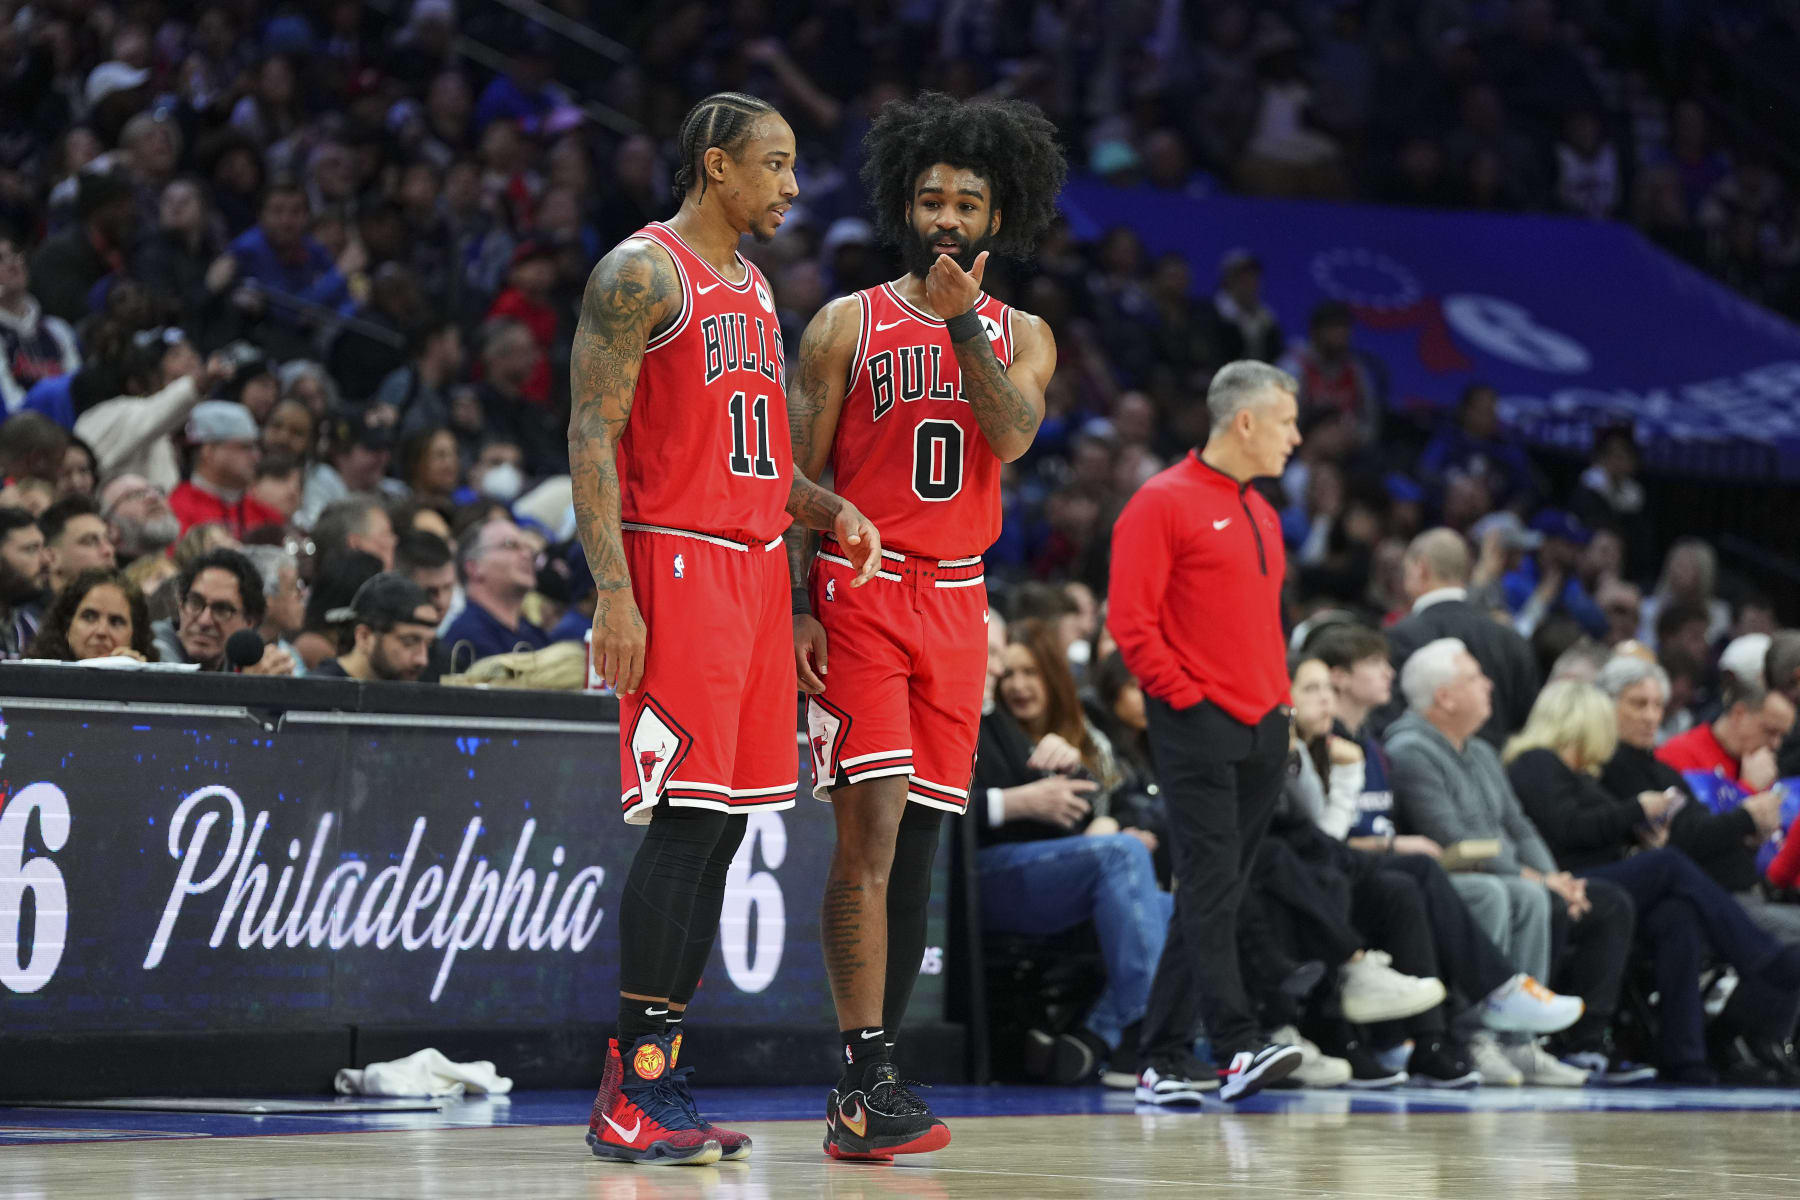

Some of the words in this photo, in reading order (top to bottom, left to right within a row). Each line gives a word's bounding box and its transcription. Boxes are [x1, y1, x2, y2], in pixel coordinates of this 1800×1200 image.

[866, 343, 1006, 422] BUL
[728, 390, 780, 479] 11
[911, 418, 965, 502] 0
[142, 784, 605, 1003] Philadelphia
